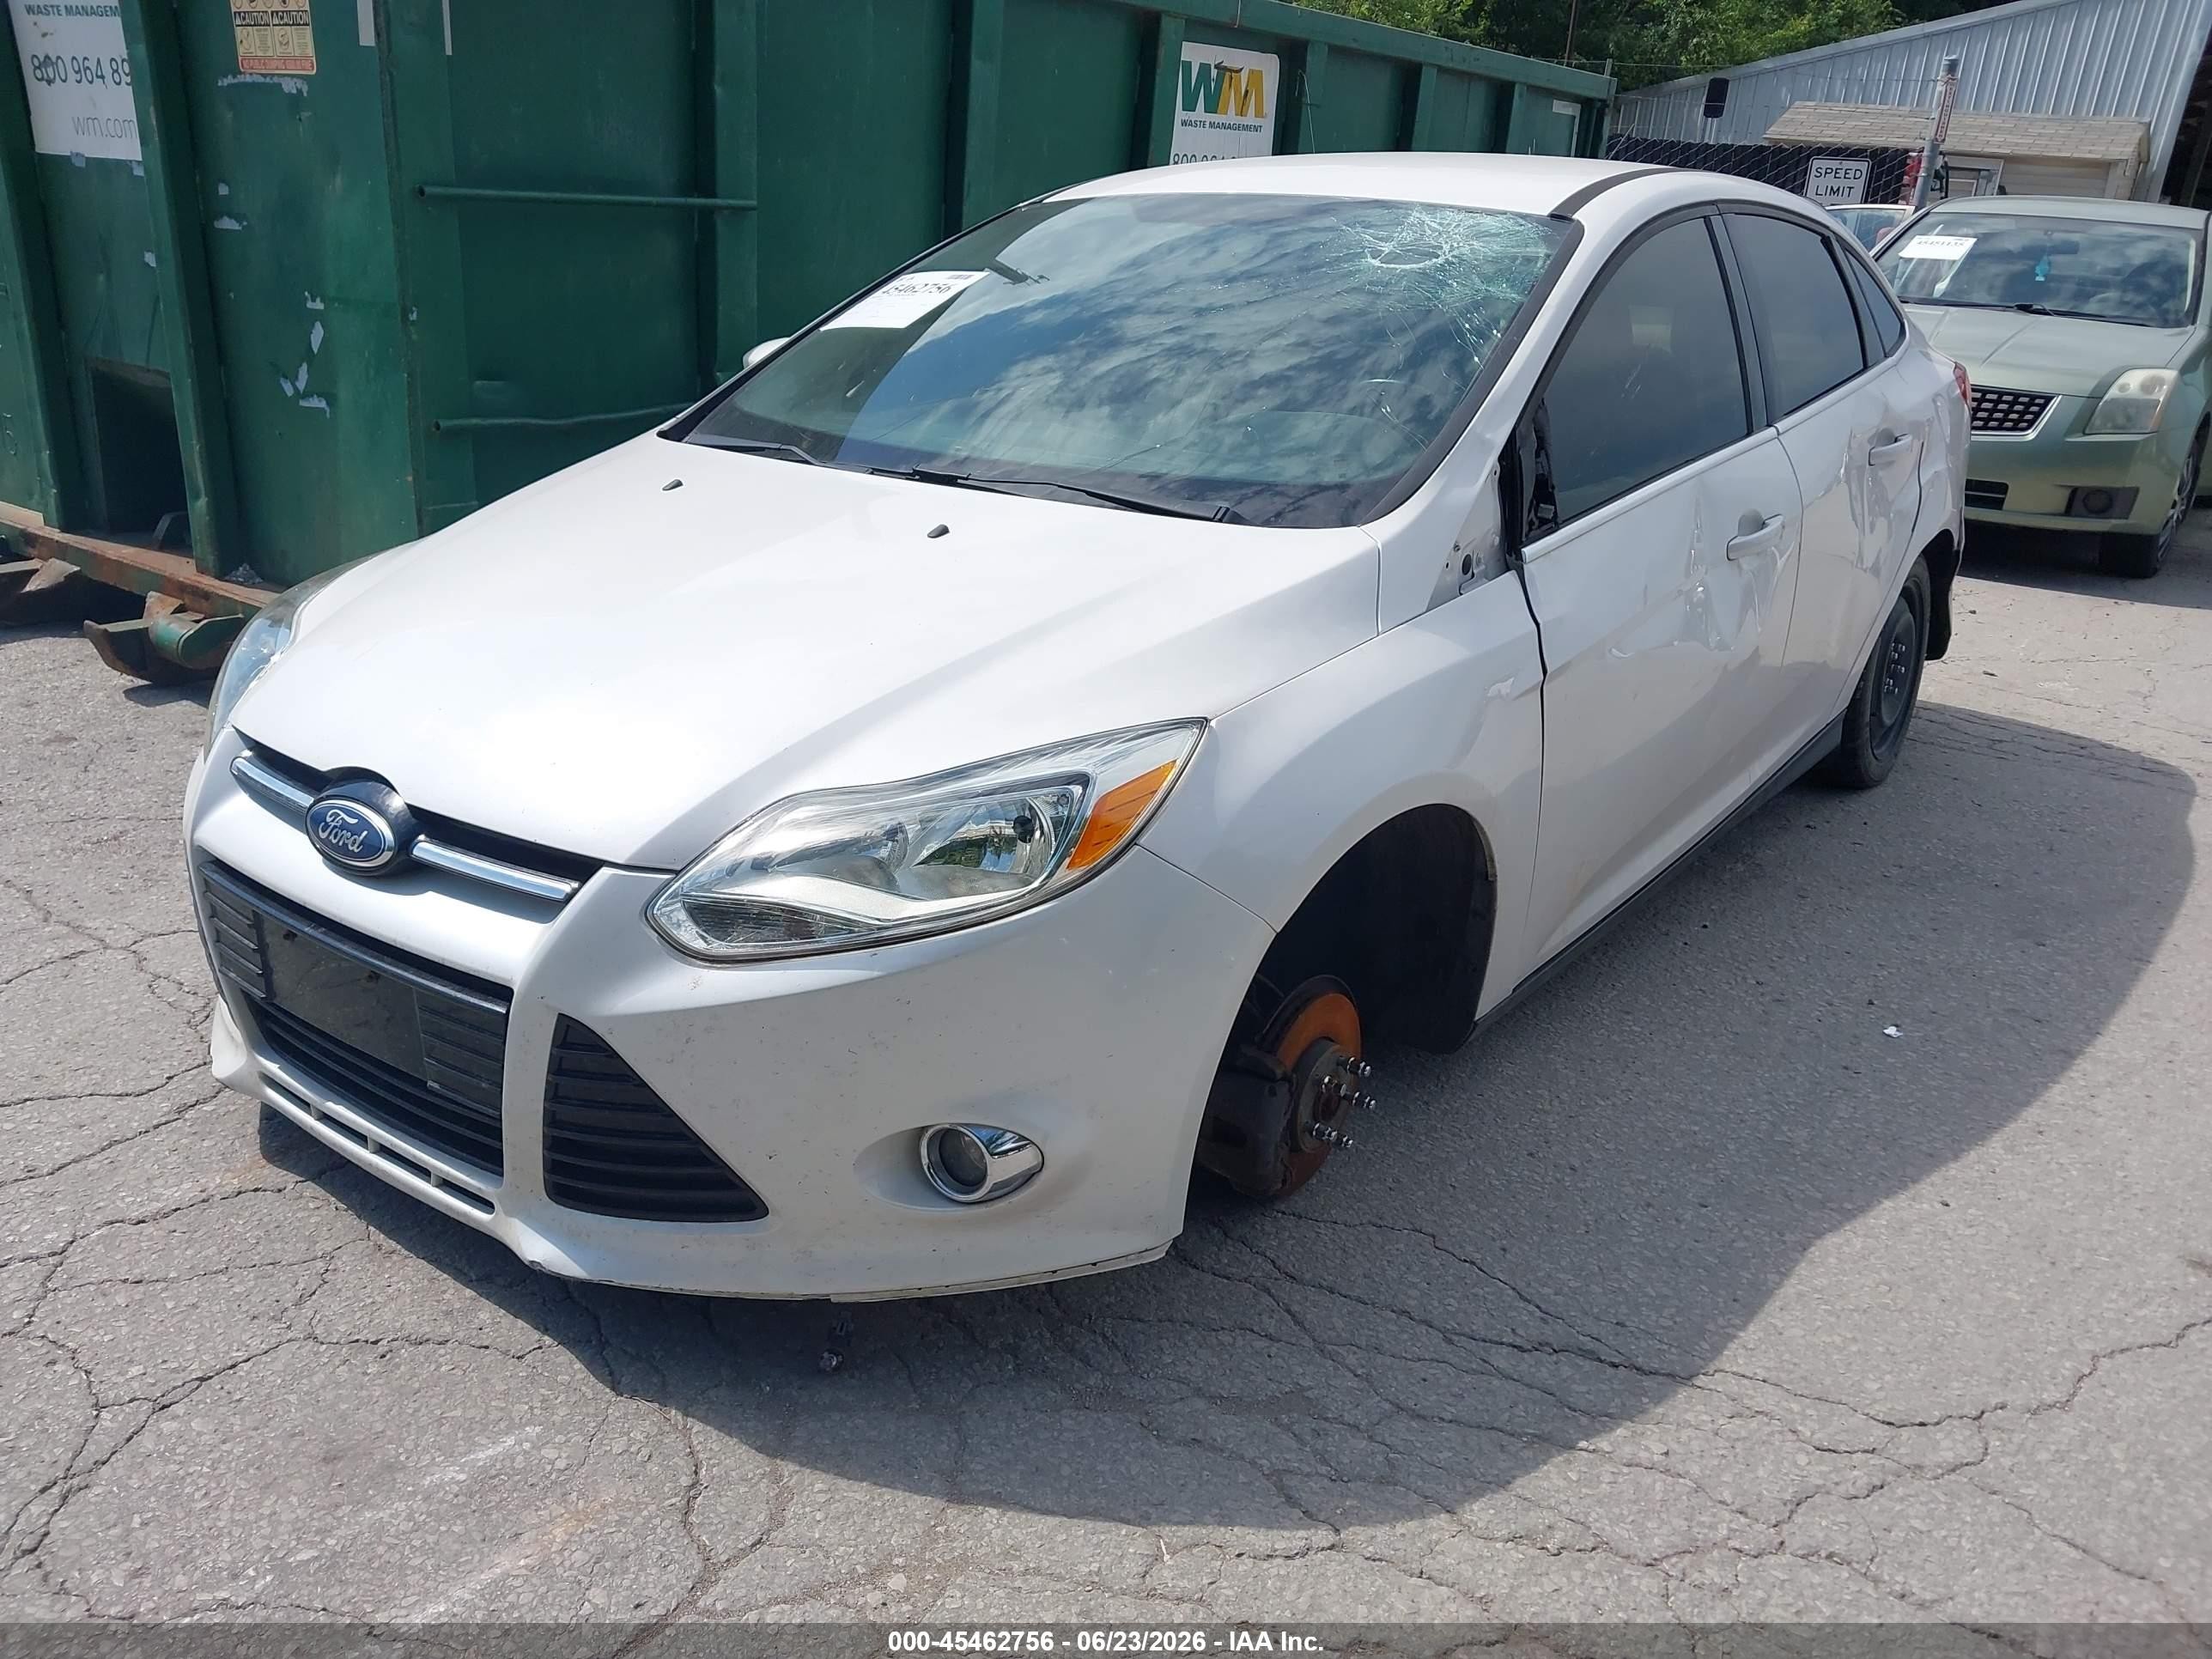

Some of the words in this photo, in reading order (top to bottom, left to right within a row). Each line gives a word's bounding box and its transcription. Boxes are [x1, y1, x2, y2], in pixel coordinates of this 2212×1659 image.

[24, 4, 62, 16] WASTE
[240, 12, 270, 25] CAUTION
[277, 11, 309, 25] CAUTION
[31, 54, 68, 84] 800
[70, 56, 106, 87] 964
[1181, 60, 1265, 118] WM
[71, 116, 137, 138] wm.com
[1181, 118, 1206, 129] WASTE
[1208, 121, 1263, 133] MANAGEMENT
[1814, 166, 1863, 180] SPEED
[1814, 185, 1855, 198] LIMIT
[319, 809, 368, 853] Ford
